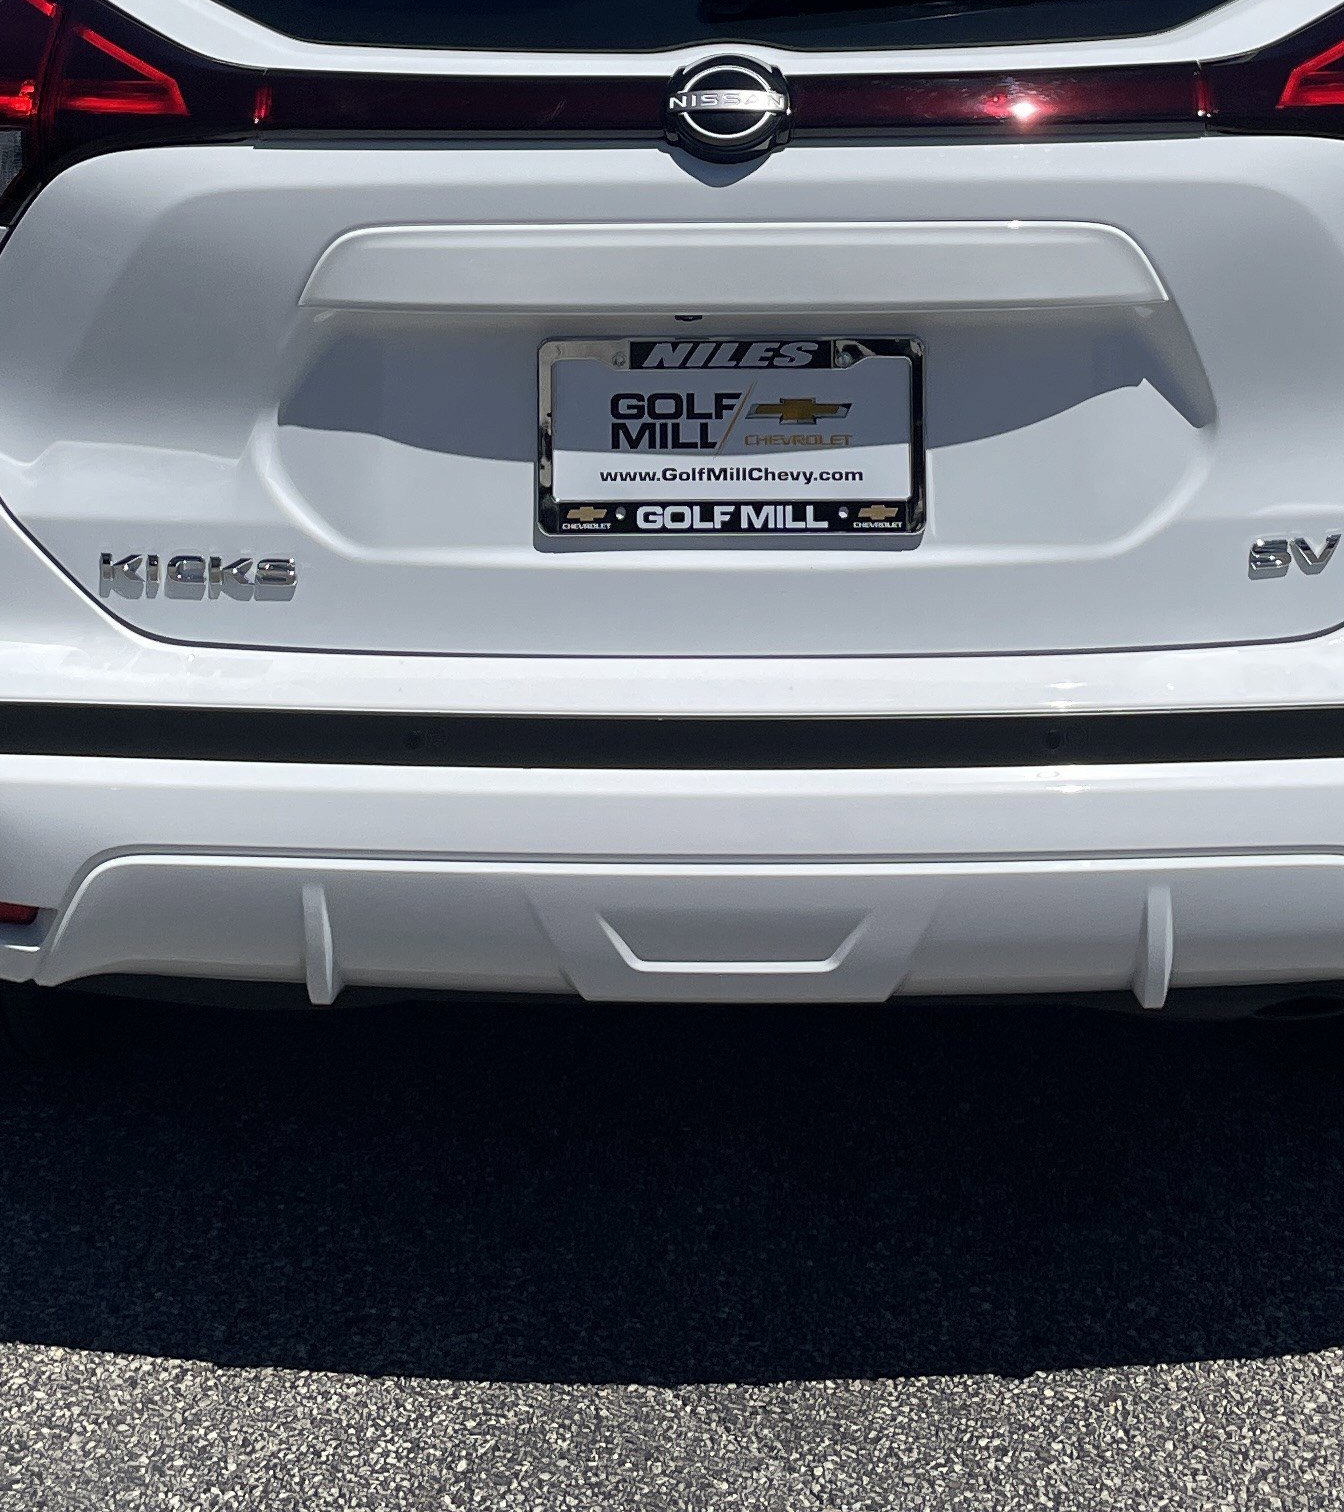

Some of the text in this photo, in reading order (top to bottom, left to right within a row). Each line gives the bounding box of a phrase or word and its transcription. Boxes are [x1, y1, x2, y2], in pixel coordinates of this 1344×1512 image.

[669, 92, 784, 109] NISSAN
[643, 342, 818, 367] NILES
[610, 392, 742, 420] GOLF
[612, 422, 720, 449] MILL
[744, 434, 853, 447] CHEVROLET
[600, 467, 863, 483] www.GolfMillChevy.com
[561, 522, 611, 530] CHEVROLET
[636, 505, 828, 529] GOLF MILL
[853, 520, 903, 529] CHEVROLET
[1248, 534, 1342, 573] SV
[99, 552, 297, 592] KICKS
